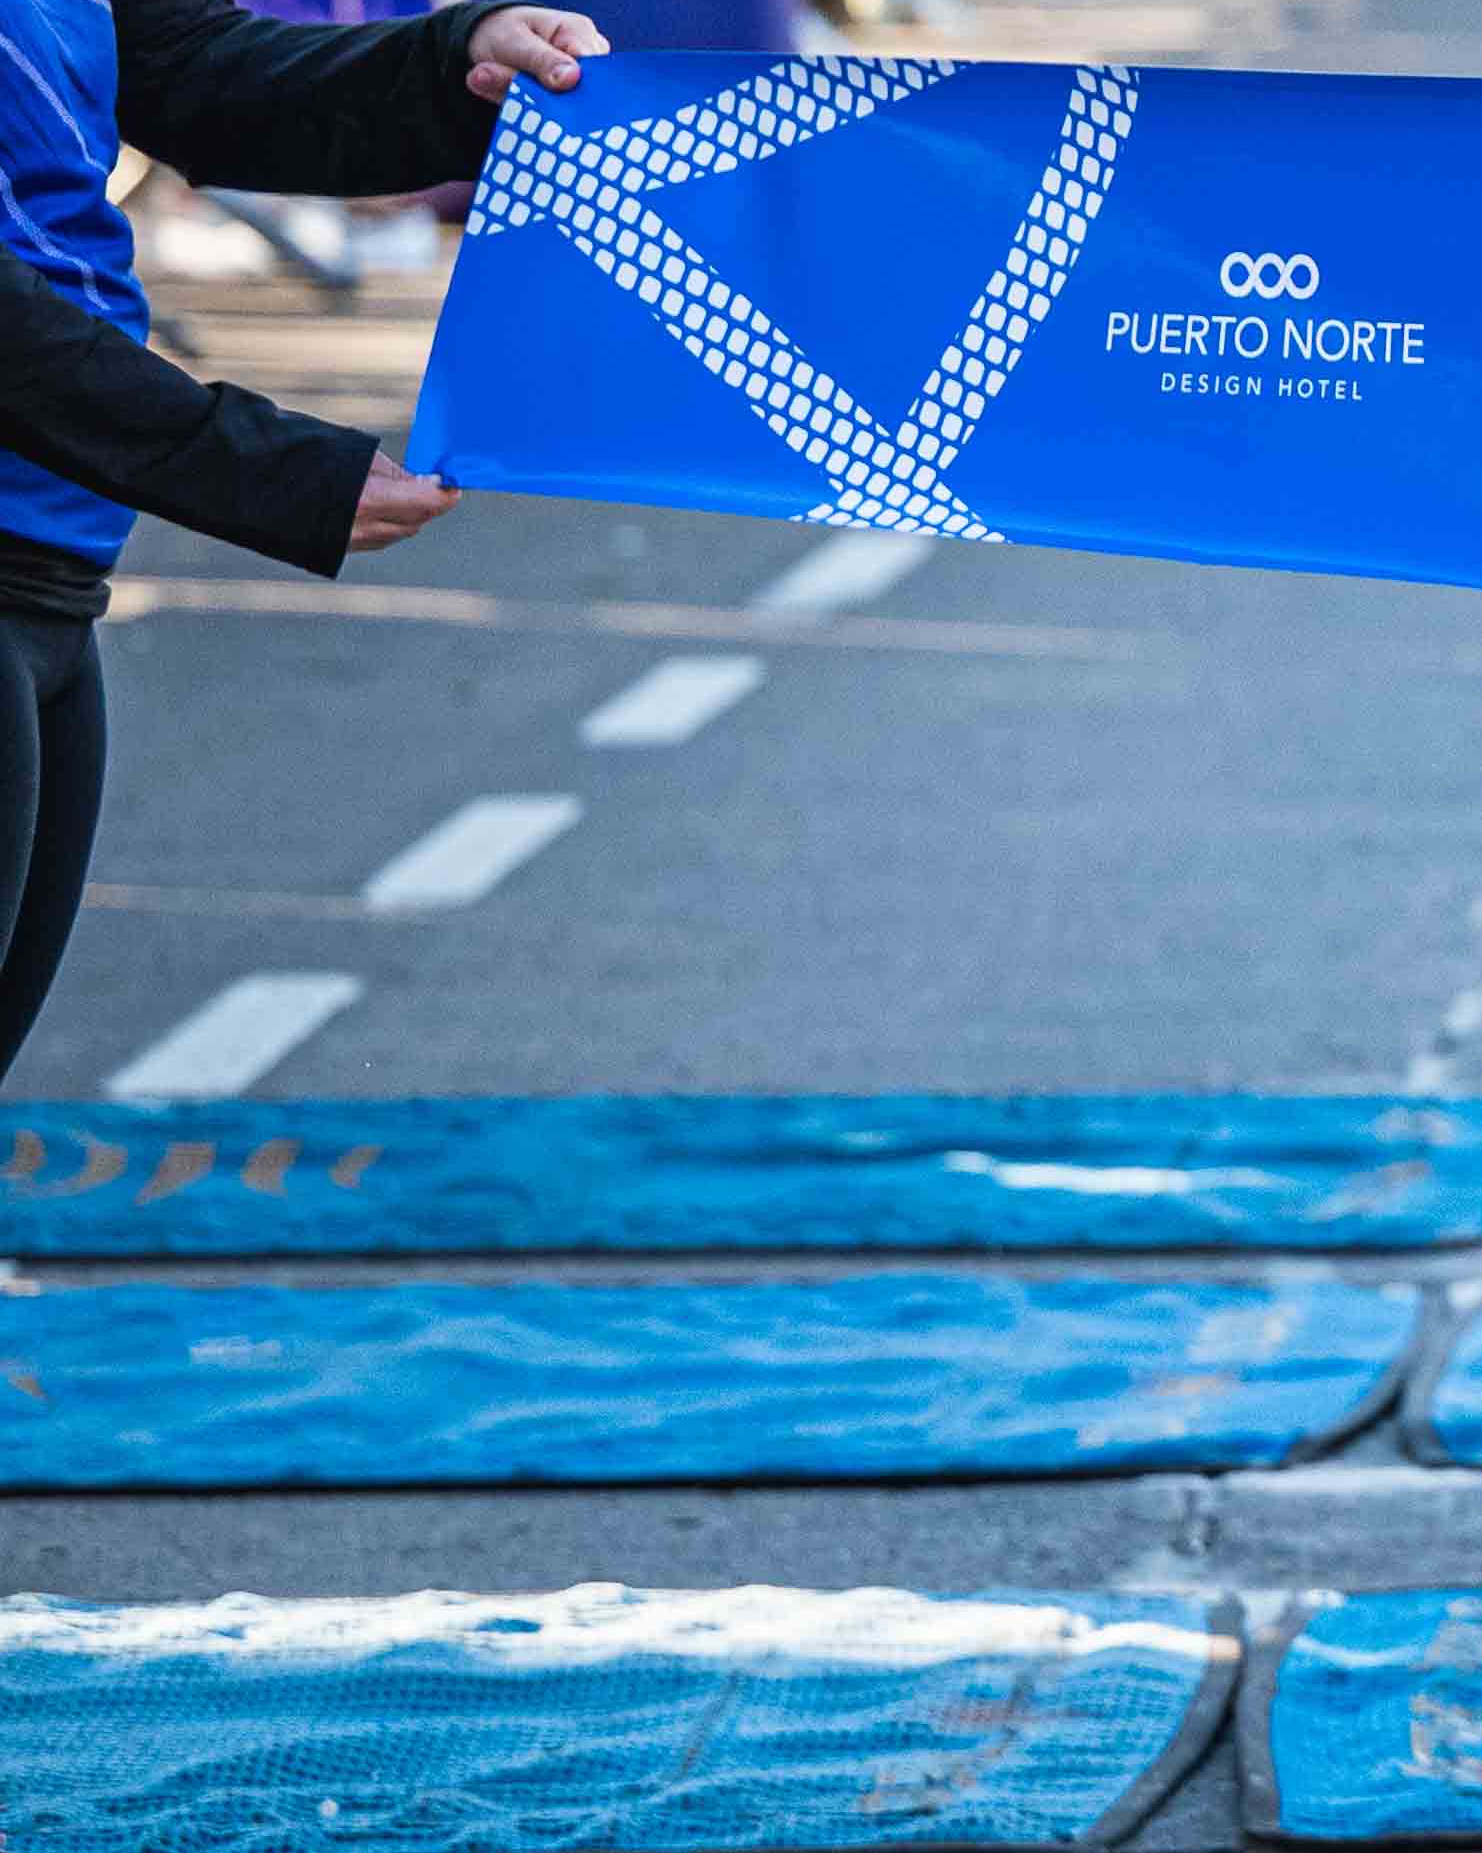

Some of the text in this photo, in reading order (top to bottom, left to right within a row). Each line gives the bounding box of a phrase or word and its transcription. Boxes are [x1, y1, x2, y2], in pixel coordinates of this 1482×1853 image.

[1105, 311, 1426, 366] PUERTO NORTE
[1160, 371, 1363, 402] DESIGN HOTEL
